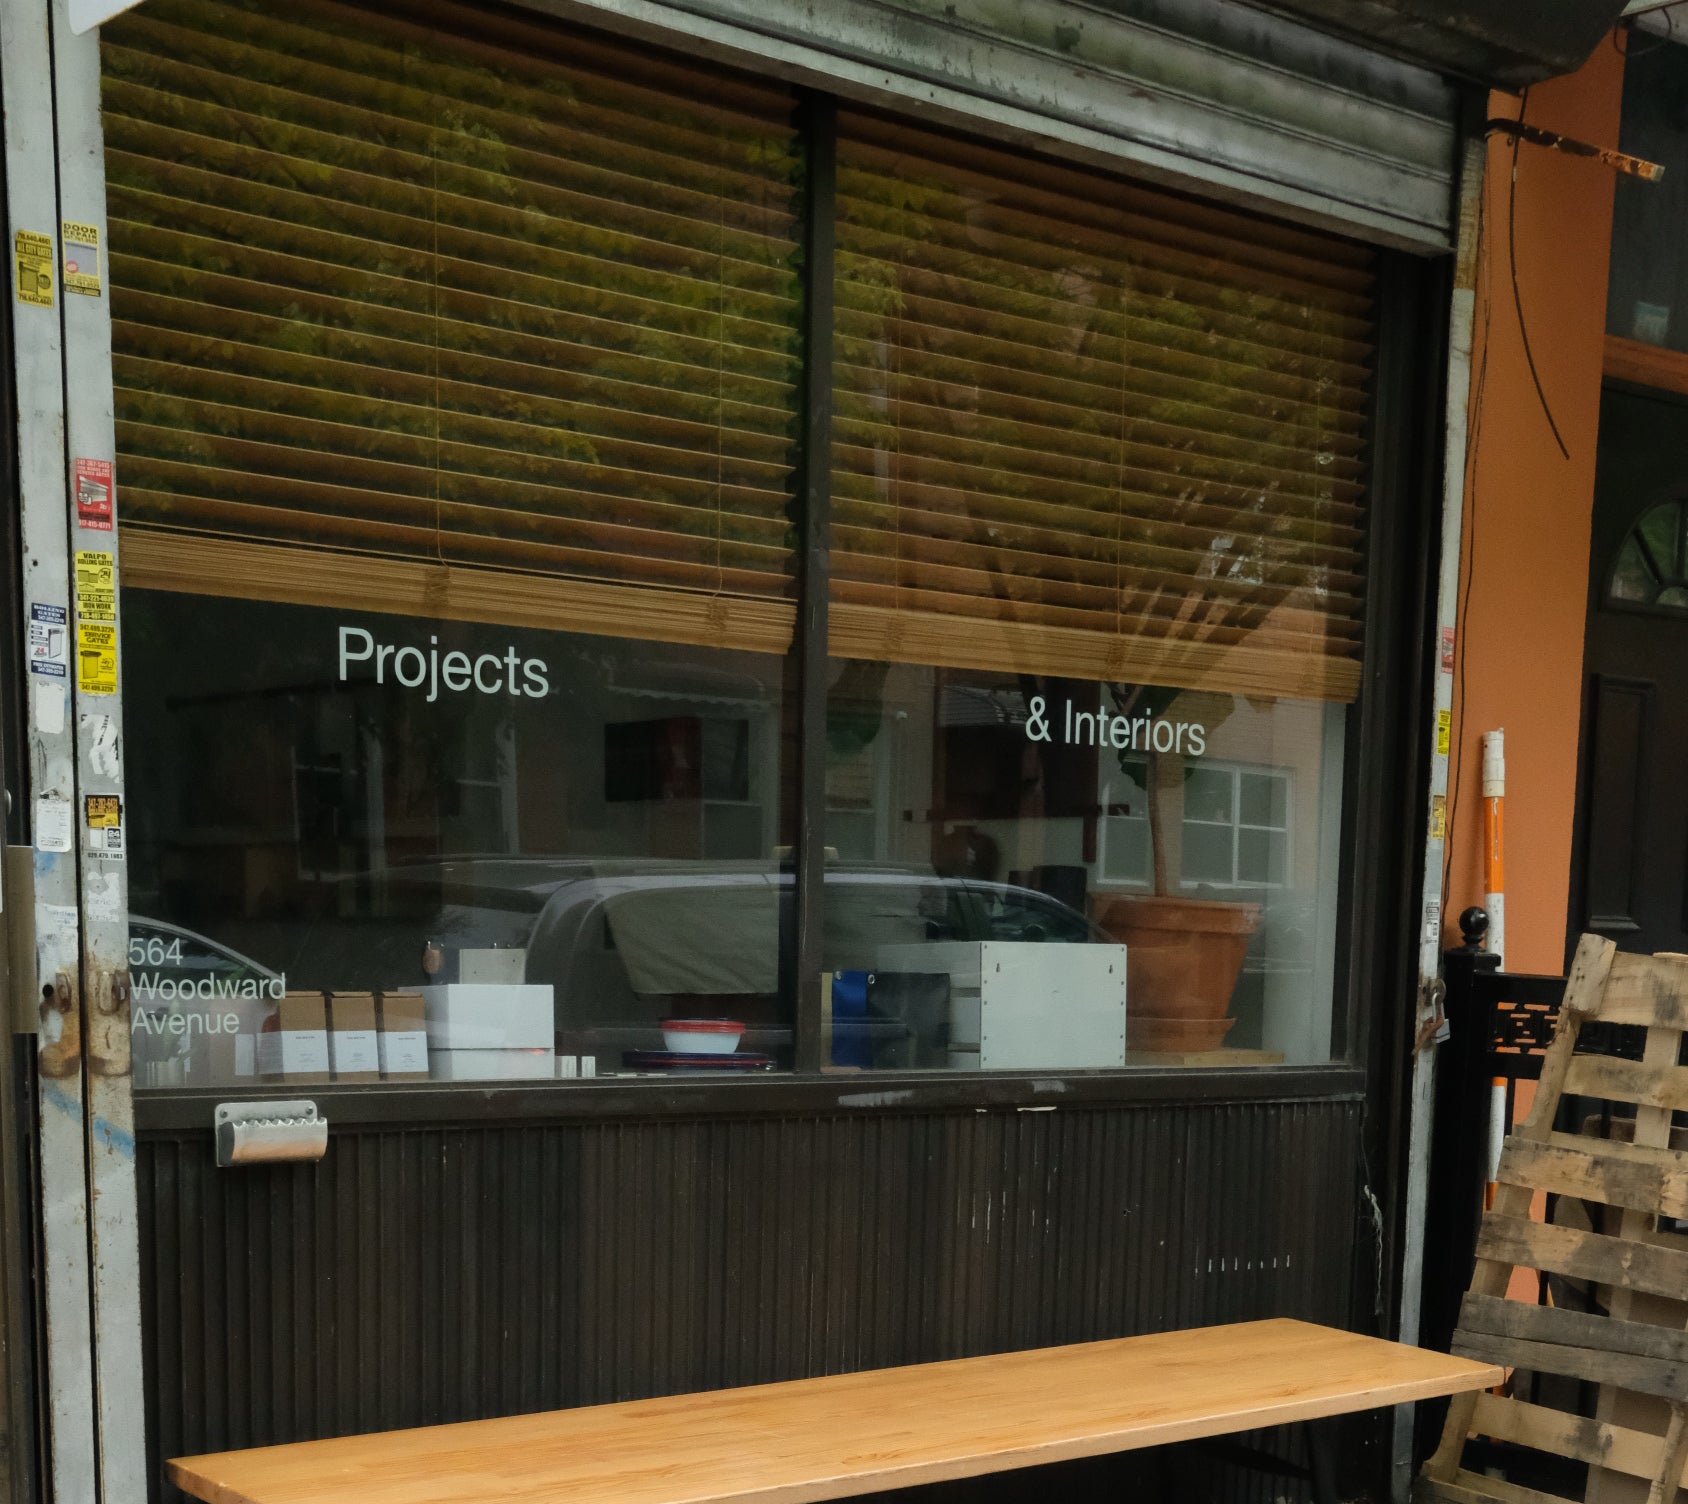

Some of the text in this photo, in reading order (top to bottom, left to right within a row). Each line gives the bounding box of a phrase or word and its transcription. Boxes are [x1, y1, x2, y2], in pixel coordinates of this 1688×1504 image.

[63, 223, 97, 234] DOOR
[63, 229, 97, 239] REPAIR
[339, 626, 549, 702] Projects
[1025, 696, 1206, 756] & Interiors
[108, 830, 120, 838] 24
[129, 938, 183, 966] 564
[129, 972, 286, 1000] Woodward
[131, 1006, 240, 1035] Avenue
